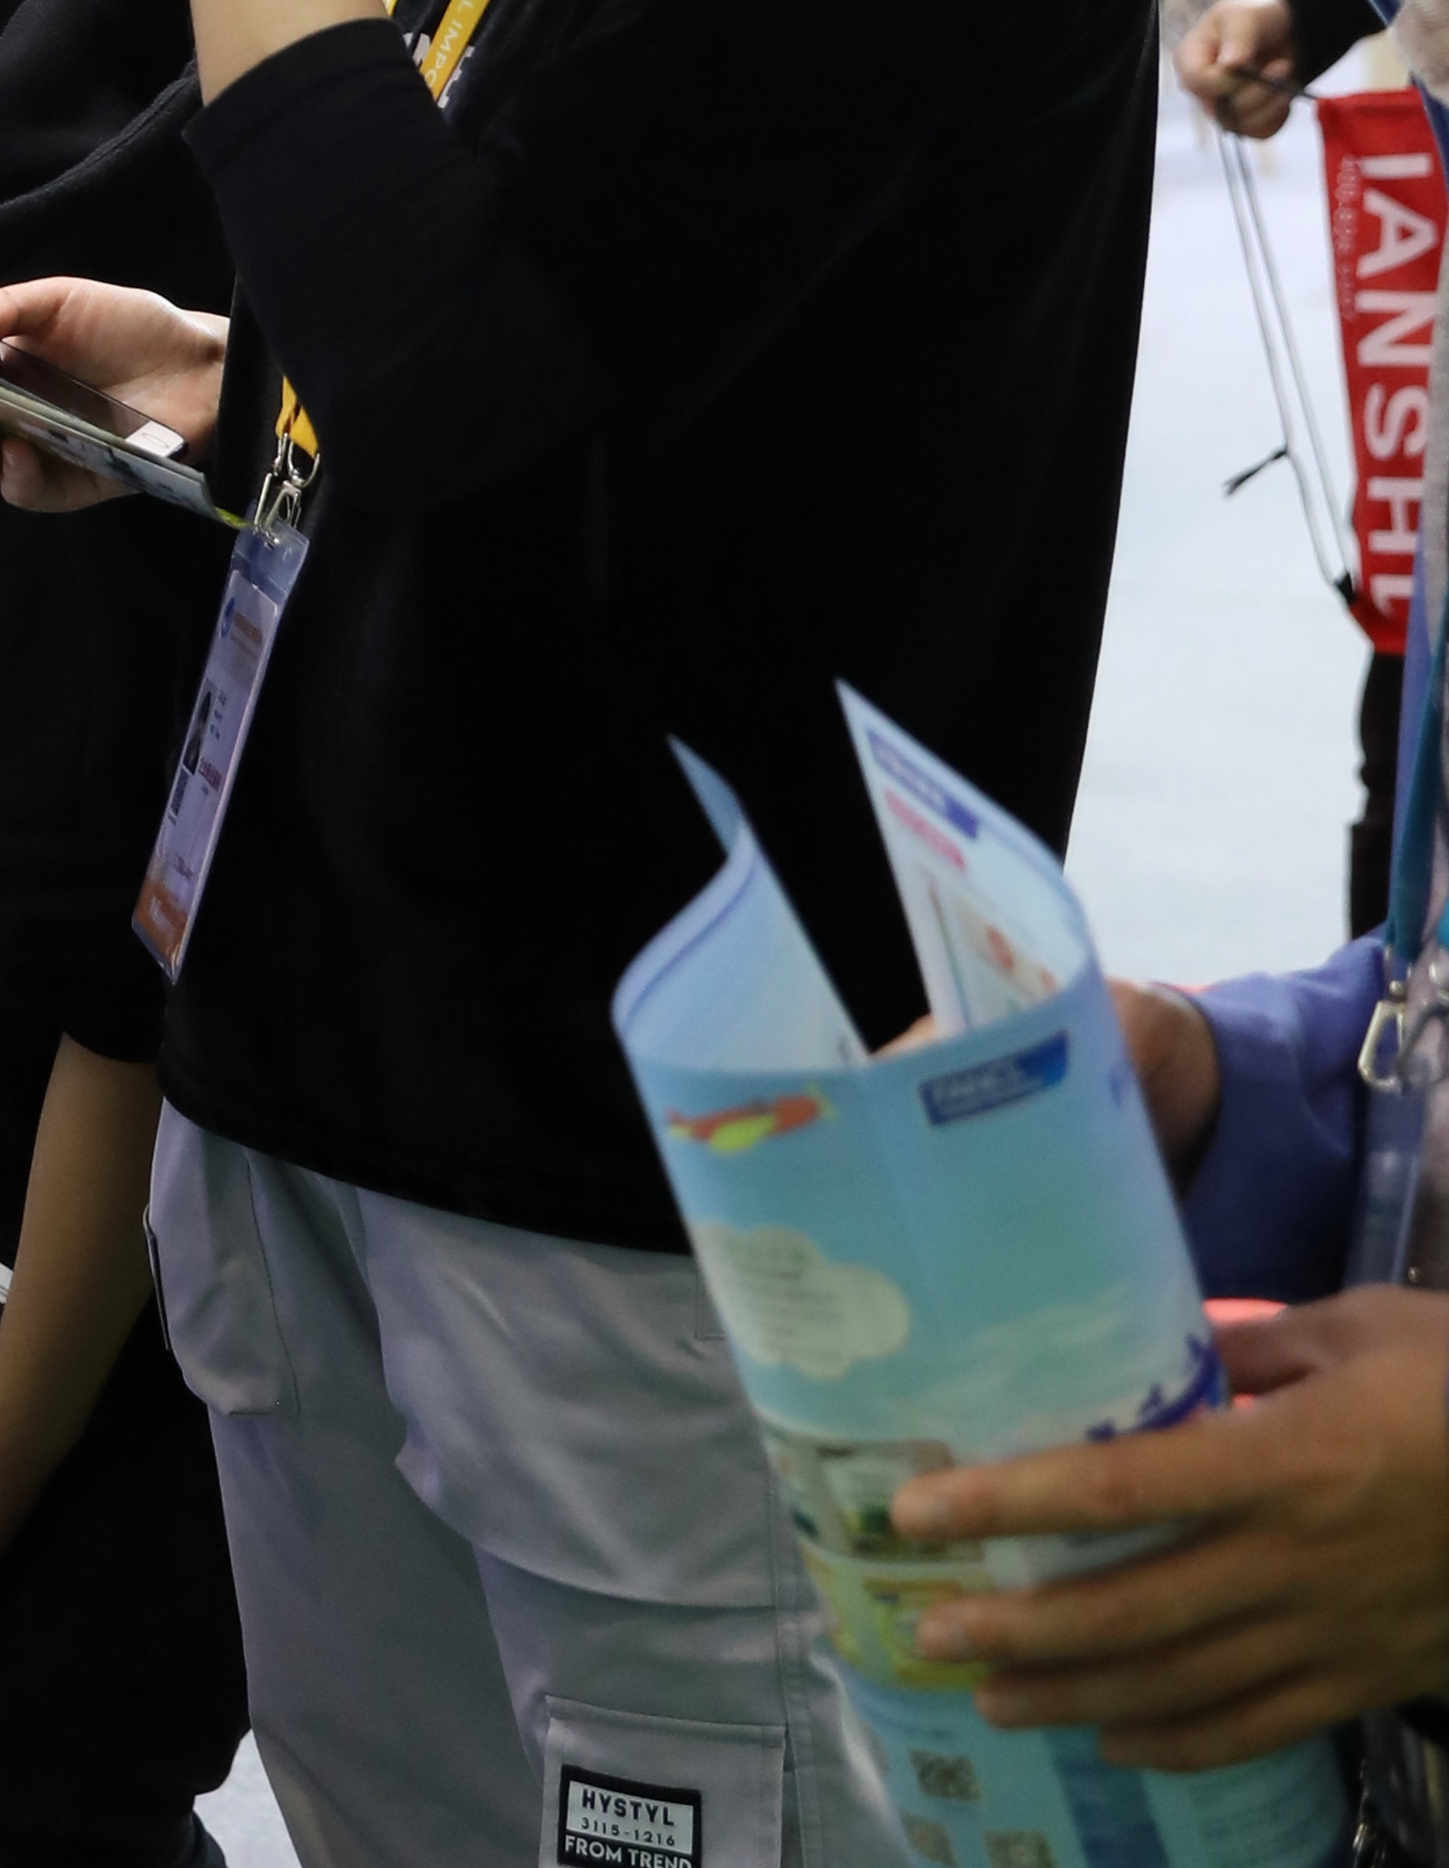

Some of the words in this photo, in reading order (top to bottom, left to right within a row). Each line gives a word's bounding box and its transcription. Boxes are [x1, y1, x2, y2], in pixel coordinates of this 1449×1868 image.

[581, 1787, 675, 1828] HYSTYL
[581, 1816, 676, 1848] 3115-1216
[564, 1834, 622, 1866] FROM
